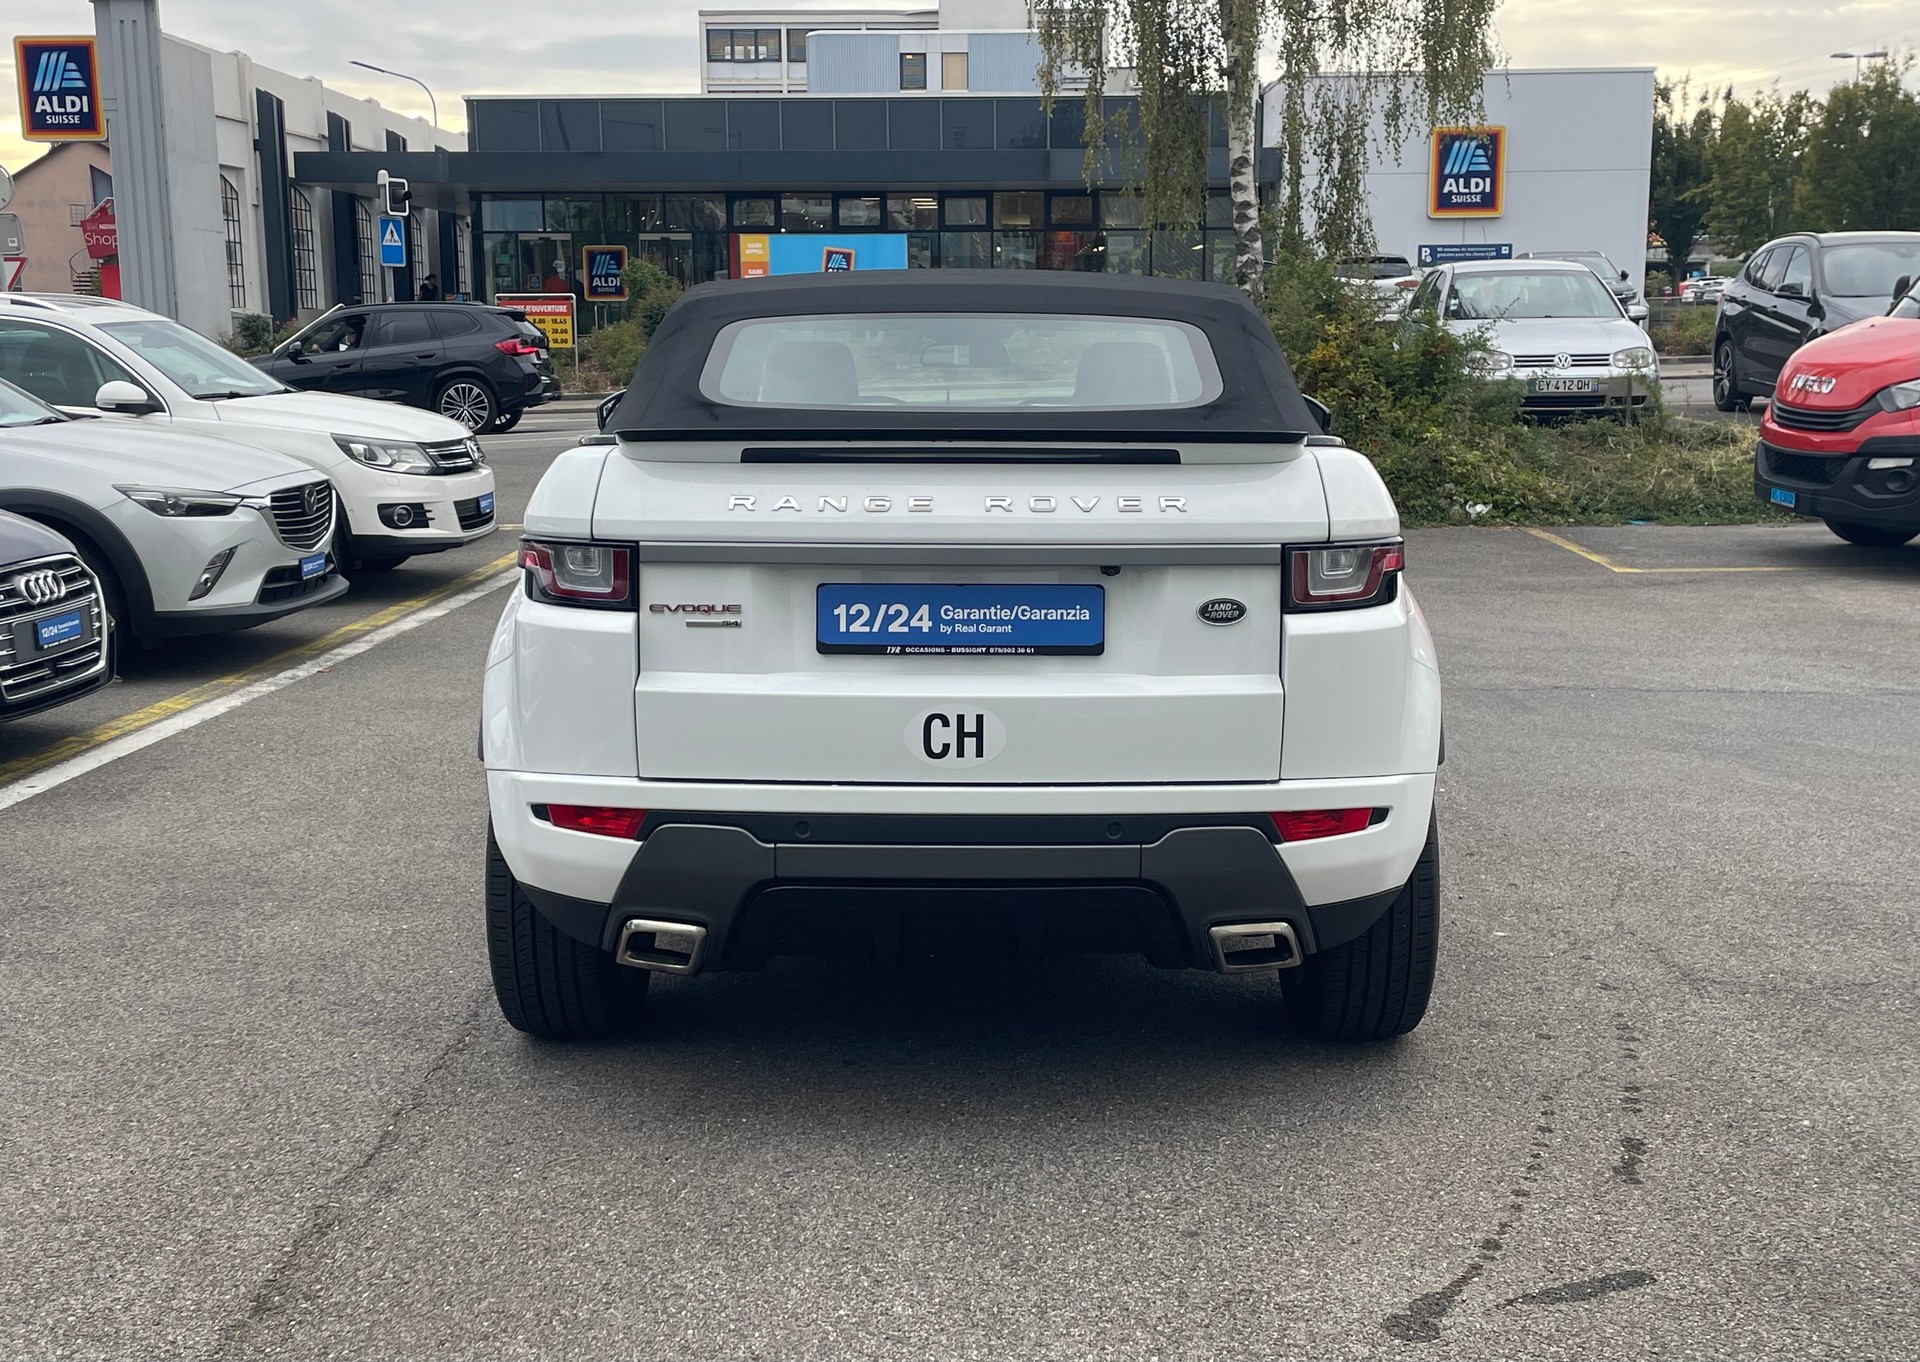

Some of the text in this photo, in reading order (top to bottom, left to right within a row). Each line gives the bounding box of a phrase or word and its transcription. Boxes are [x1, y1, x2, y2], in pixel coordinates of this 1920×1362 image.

[35, 95, 89, 113] ALDI
[45, 115, 81, 124] SUISSE
[1442, 177, 1491, 194] ALDI
[1451, 194, 1482, 203] SUISSE
[592, 276, 621, 287] ALDI
[728, 494, 1188, 513] RANGE ROVER
[649, 604, 742, 614] EVOQUE
[1207, 603, 1232, 611] LAND
[833, 603, 1090, 633] 12/24 Garantie/Garanzia
[1210, 610, 1239, 619] ROVER
[940, 623, 1012, 634] by Real Garant
[923, 713, 984, 759] CH
